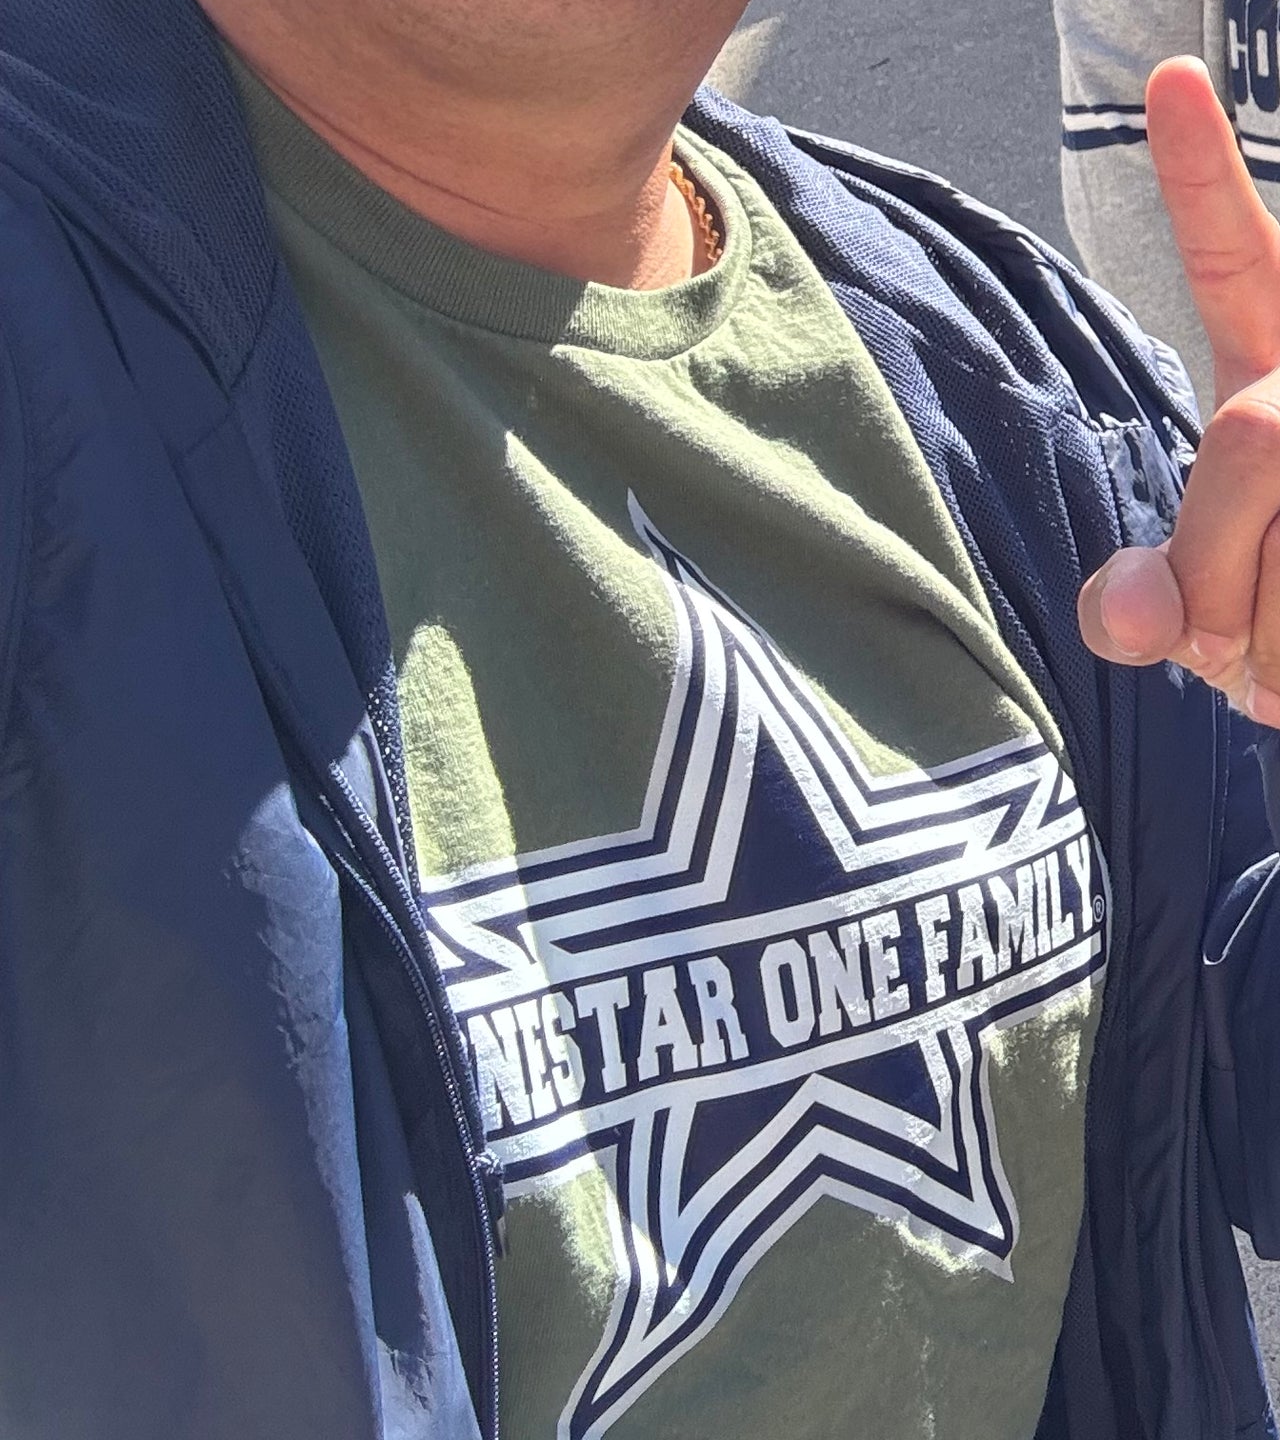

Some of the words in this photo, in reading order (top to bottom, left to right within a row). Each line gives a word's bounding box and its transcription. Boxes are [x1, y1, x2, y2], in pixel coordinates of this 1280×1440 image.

[464, 998, 560, 1134] NE
[540, 955, 750, 1108] STAR
[759, 910, 912, 1048] ONE
[914, 834, 1093, 1005] FAMILY
